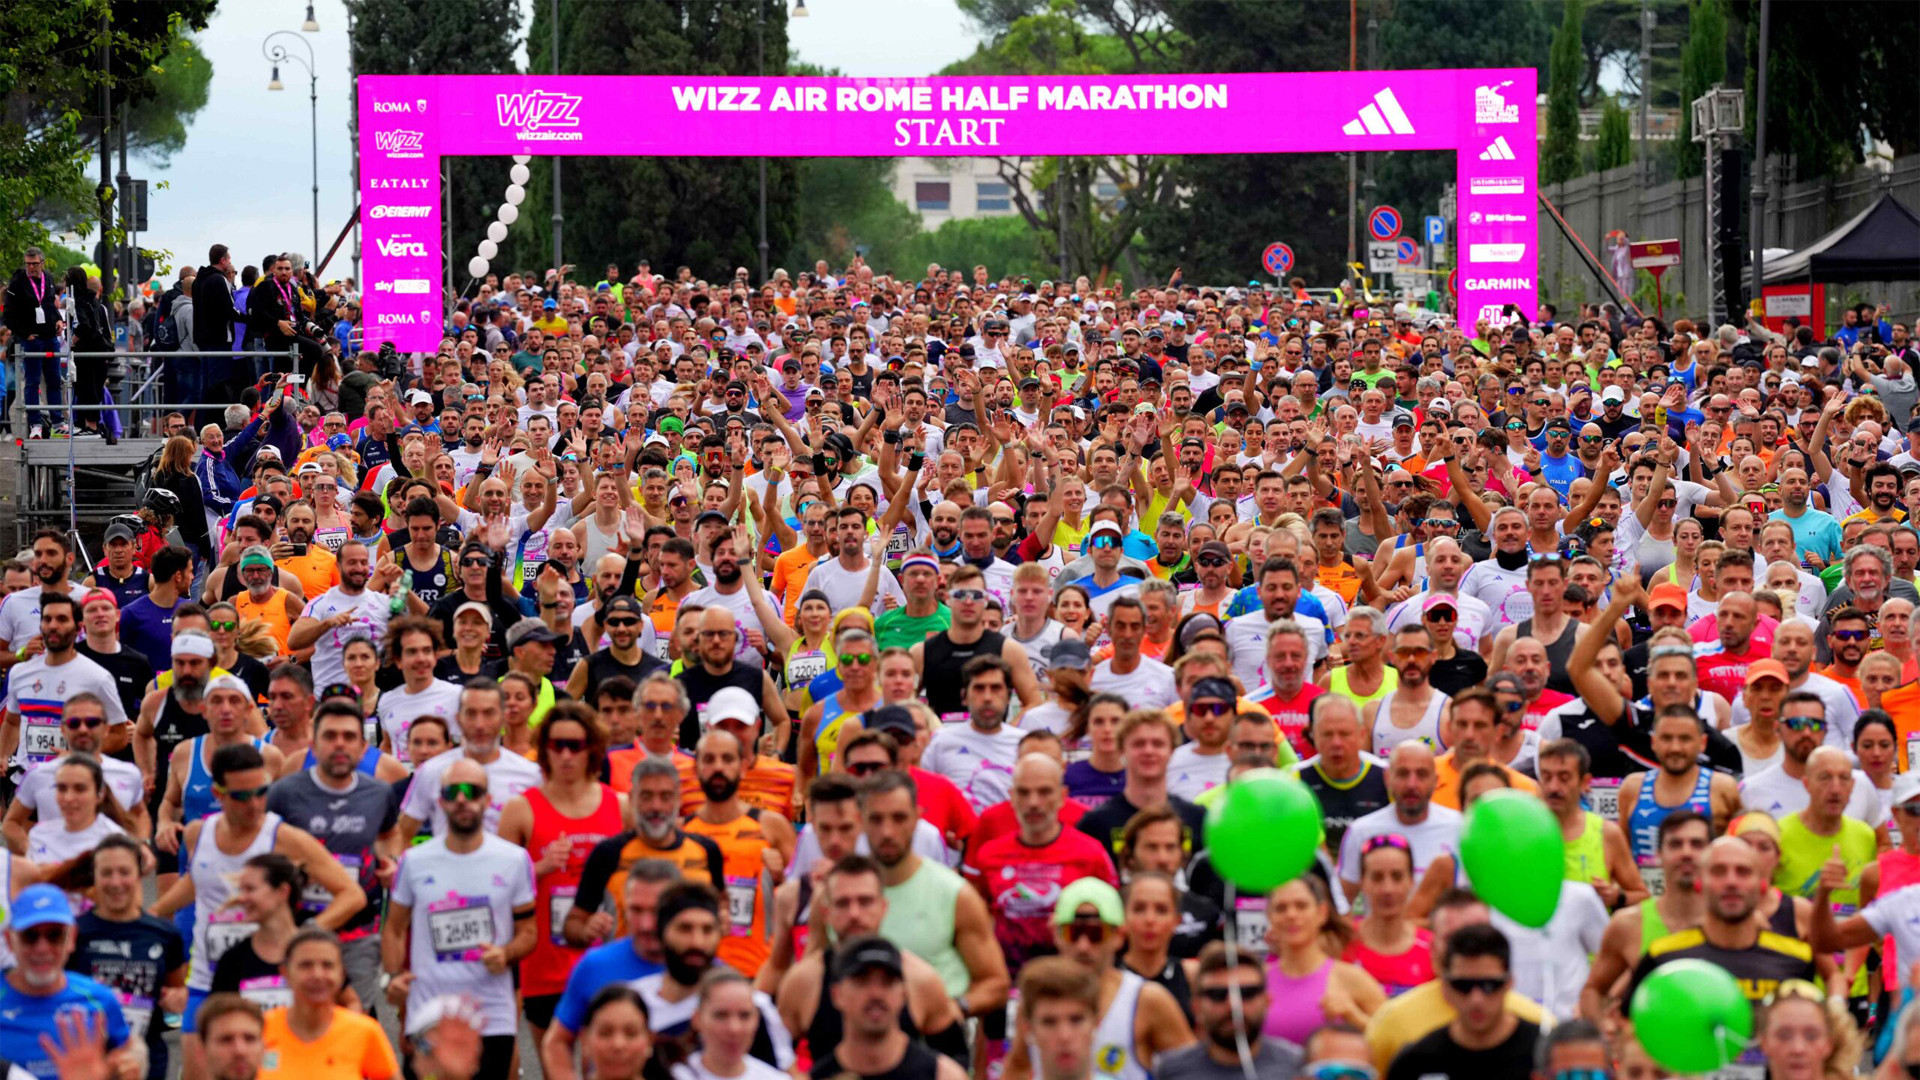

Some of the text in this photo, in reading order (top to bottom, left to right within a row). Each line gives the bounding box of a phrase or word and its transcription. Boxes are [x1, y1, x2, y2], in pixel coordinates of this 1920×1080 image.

[672, 84, 1228, 111] WIZZ AIR ROME HALF MARATHON
[374, 102, 411, 112] ROMA
[516, 131, 582, 141] wizzair.com
[894, 118, 1005, 146] START
[370, 179, 429, 188] EATALY
[1429, 220, 1443, 242] P
[374, 281, 393, 292] sky
[1464, 278, 1531, 290] GARMIN
[378, 313, 415, 324] ROMA
[794, 665, 817, 682] 2206
[36, 734, 55, 749] 954
